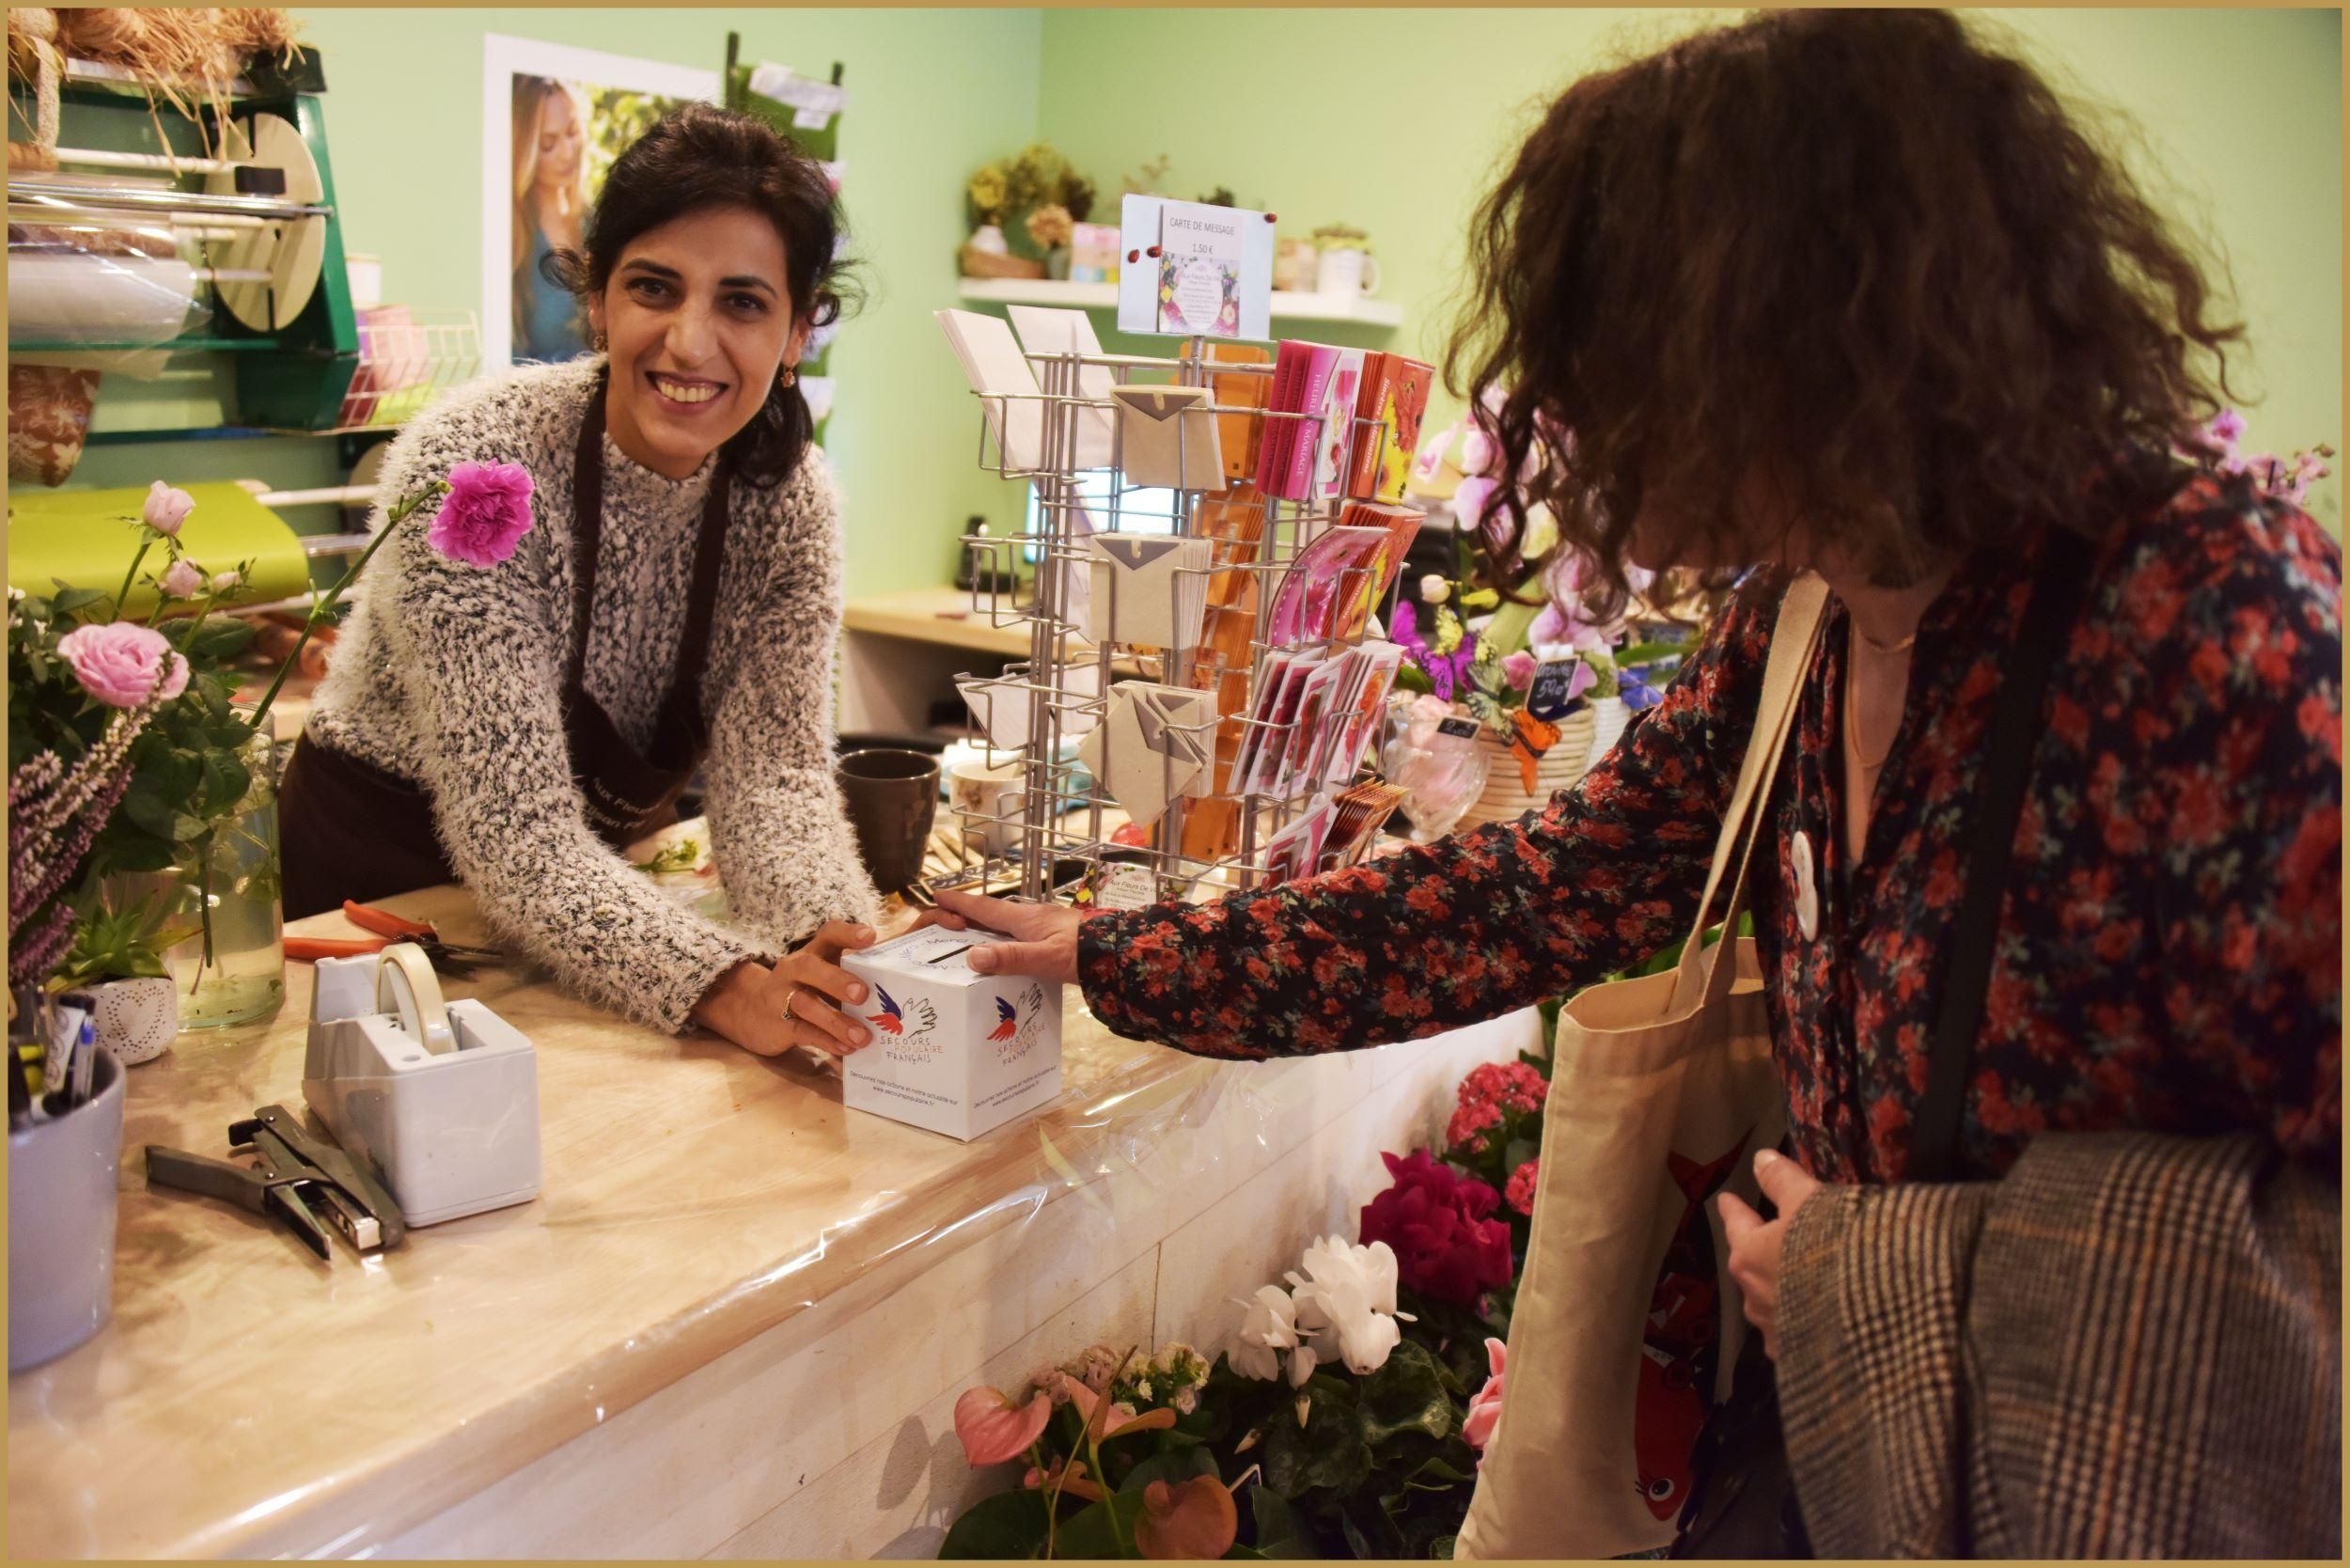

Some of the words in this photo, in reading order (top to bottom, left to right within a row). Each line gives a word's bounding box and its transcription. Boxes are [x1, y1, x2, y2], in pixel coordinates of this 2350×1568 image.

[1169, 217, 1191, 229] CARTE
[1193, 221, 1202, 231] DE
[1204, 222, 1234, 235] MESSAGE
[1209, 245, 1214, 255] €
[1377, 376, 1391, 416] Sincères
[1297, 429, 1312, 475] MARIAGE
[880, 1035, 931, 1046] SECOURS
[996, 1022, 1037, 1057] SECOURS
[895, 1045, 943, 1053] POPULAIRE
[886, 1051, 931, 1066] FRANÇAIS
